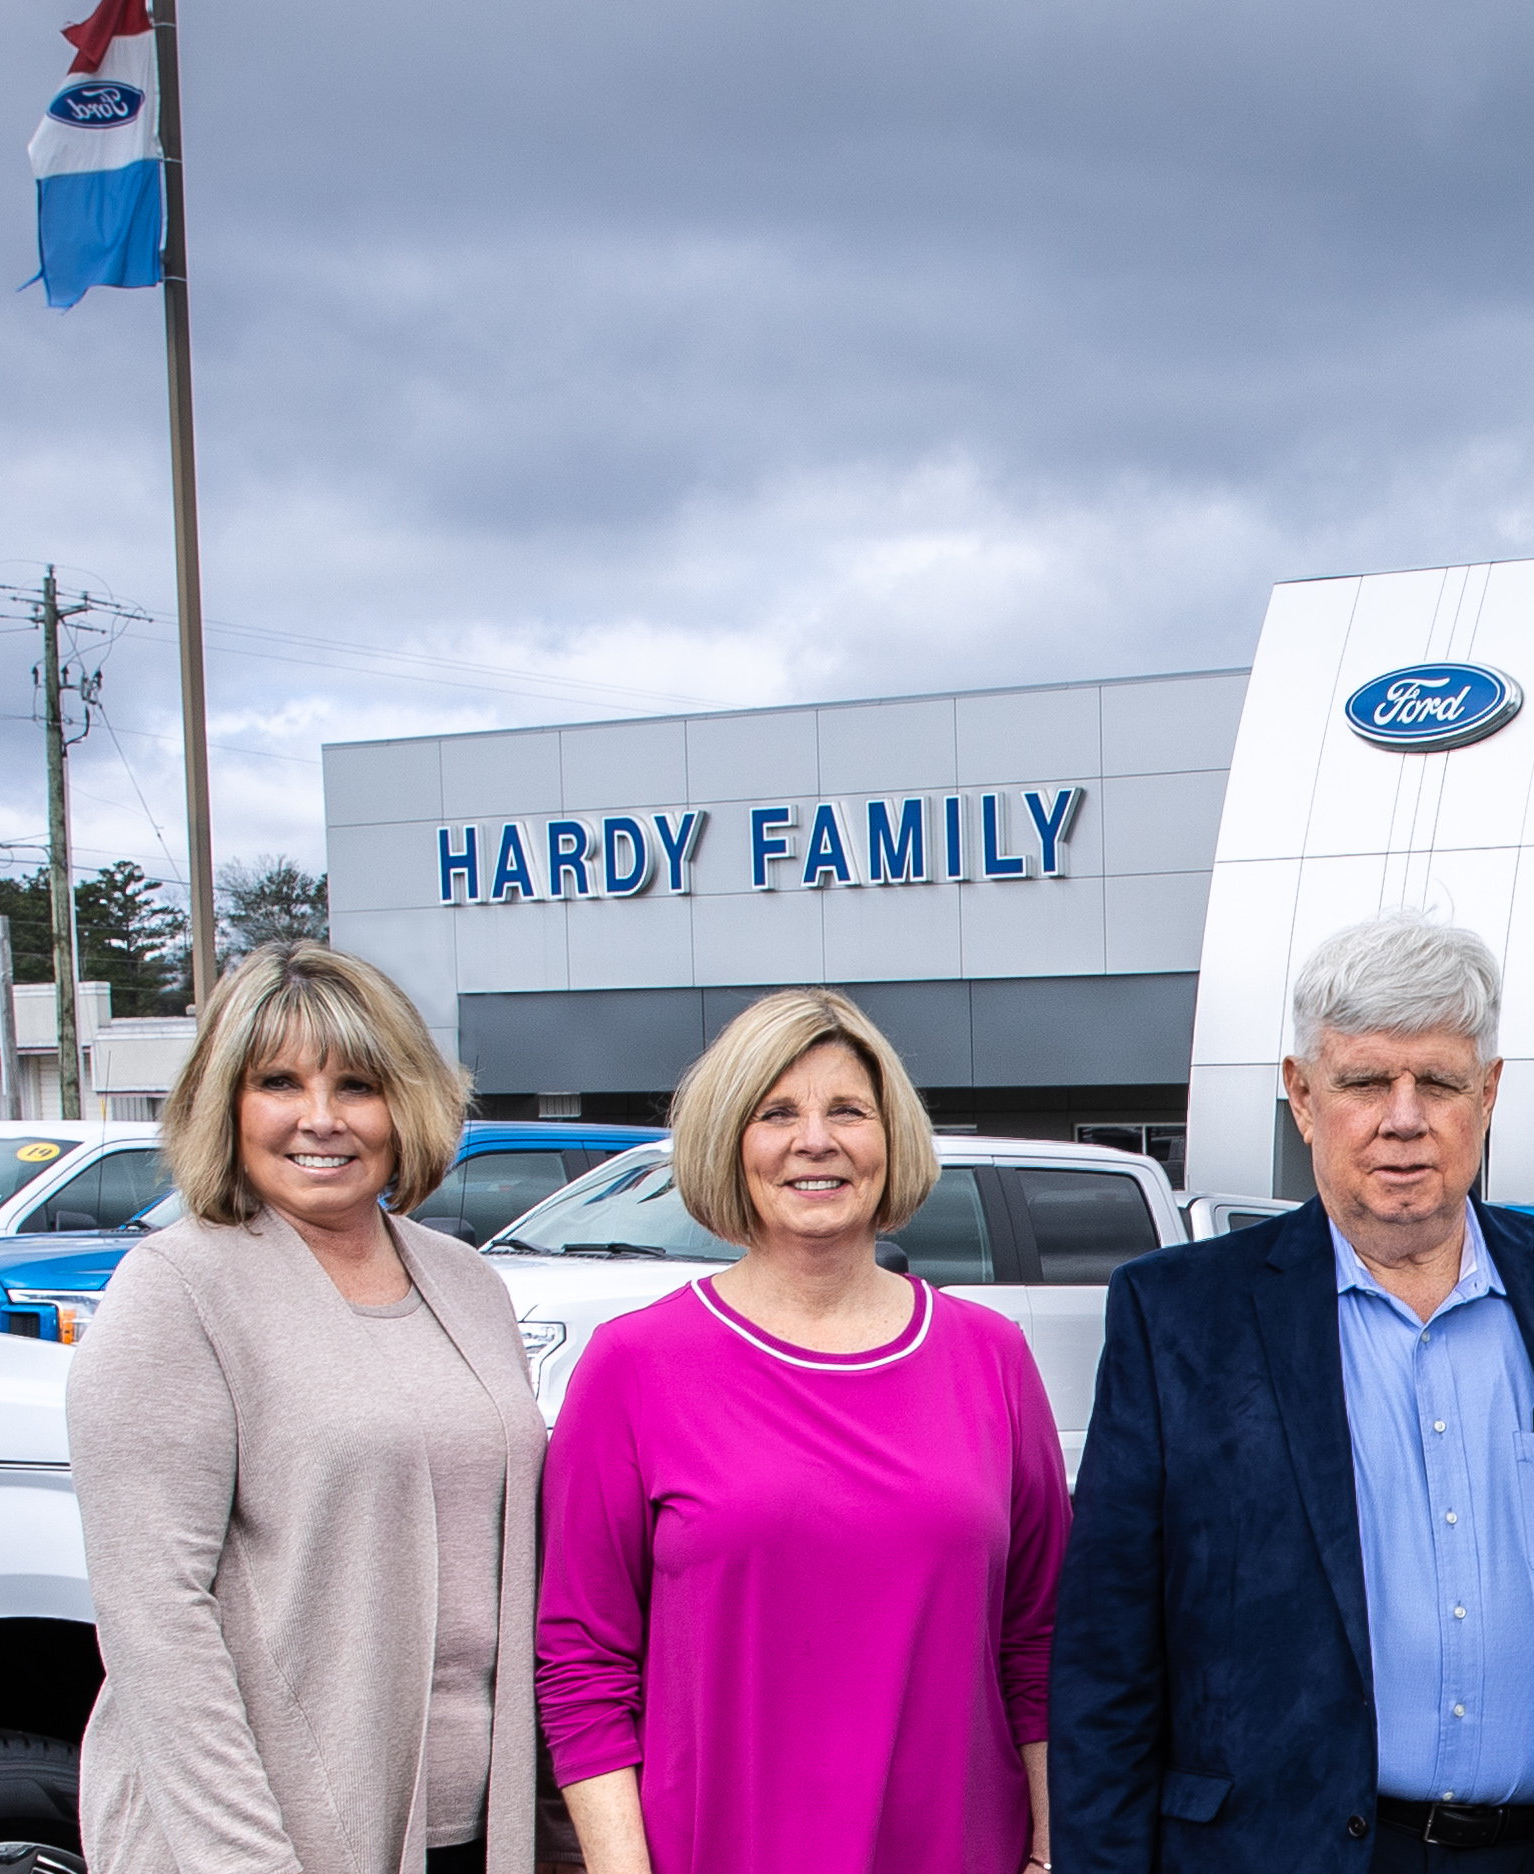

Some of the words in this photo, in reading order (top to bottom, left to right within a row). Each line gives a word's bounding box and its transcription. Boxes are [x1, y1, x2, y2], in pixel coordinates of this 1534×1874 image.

[1373, 677, 1471, 726] Ford
[436, 809, 707, 905] HARDY
[749, 786, 1084, 890] FAMILY
[26, 1147, 52, 1158] 19
